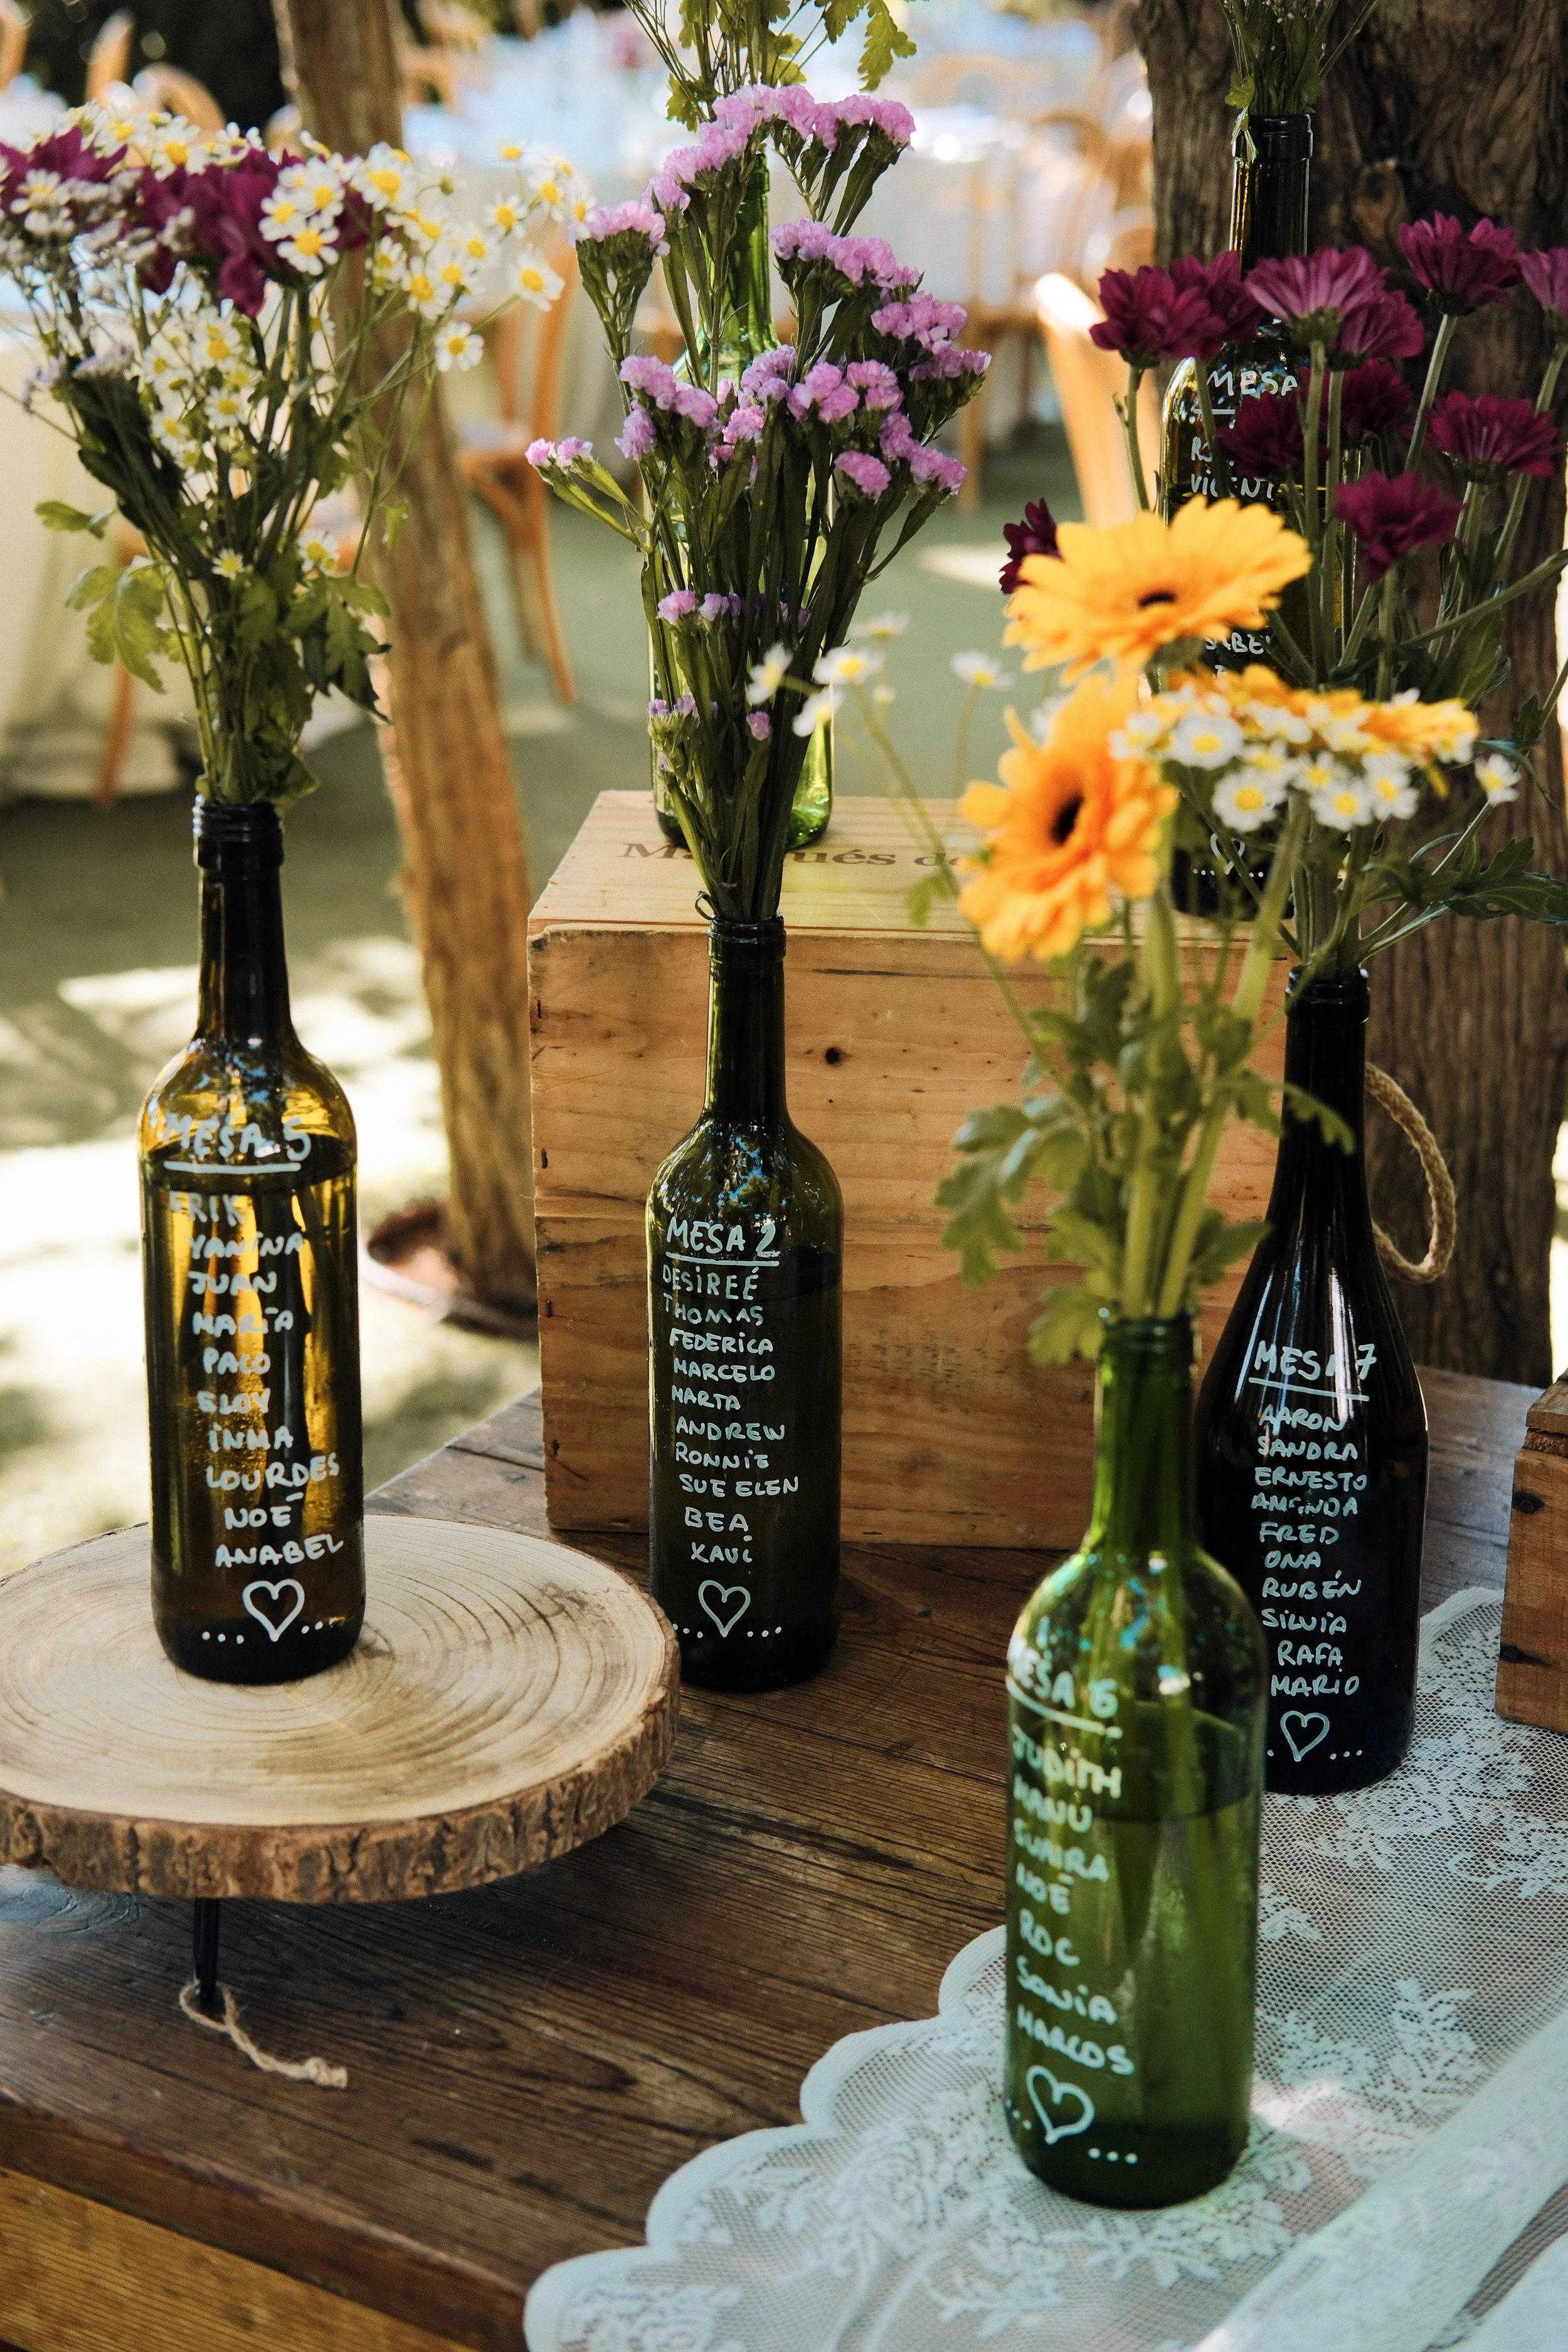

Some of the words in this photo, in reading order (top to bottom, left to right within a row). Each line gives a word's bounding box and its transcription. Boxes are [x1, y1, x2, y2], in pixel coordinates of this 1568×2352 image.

[1207, 371, 1298, 396] MESA
[1191, 469, 1274, 499] VICNT
[614, 843, 896, 866] Mués
[164, 1113, 263, 1160] MESA
[283, 1117, 312, 1161] 5
[169, 1191, 246, 1227] ERIK
[667, 1216, 746, 1254] MESA
[756, 1222, 780, 1258] 2
[188, 1271, 277, 1296] JUAN
[663, 1293, 763, 1327] THOMAS
[203, 1347, 271, 1375] PACO
[673, 1357, 775, 1382] MARCELO
[1357, 1343, 1377, 1380] 7
[197, 1387, 271, 1415] ELOY
[671, 1385, 741, 1411] MARTA
[676, 1416, 785, 1441] ANDREW
[1259, 1404, 1348, 1433] AARON
[1258, 1436, 1359, 1461] SANDRA
[206, 1452, 340, 1491] LOURDES
[679, 1474, 726, 1497] SUE
[736, 1476, 798, 1496] ELEN
[1255, 1466, 1368, 1492] ERNESTO
[225, 1491, 304, 1530] NOÉ
[684, 1507, 749, 1532] BEA
[1259, 1521, 1339, 1545] FRED
[215, 1534, 344, 1568] ANABEL
[1264, 1550, 1322, 1569] ONA
[1262, 1570, 1362, 1599] RUBÉN
[1278, 1640, 1343, 1668] RAFA
[1009, 1643, 1076, 1709] ESA
[1088, 1678, 1119, 1719] 6
[1013, 1772, 1093, 1833] MANU
[1019, 1908, 1080, 1967] ROC
[1017, 2005, 1135, 2076] MARCOS
